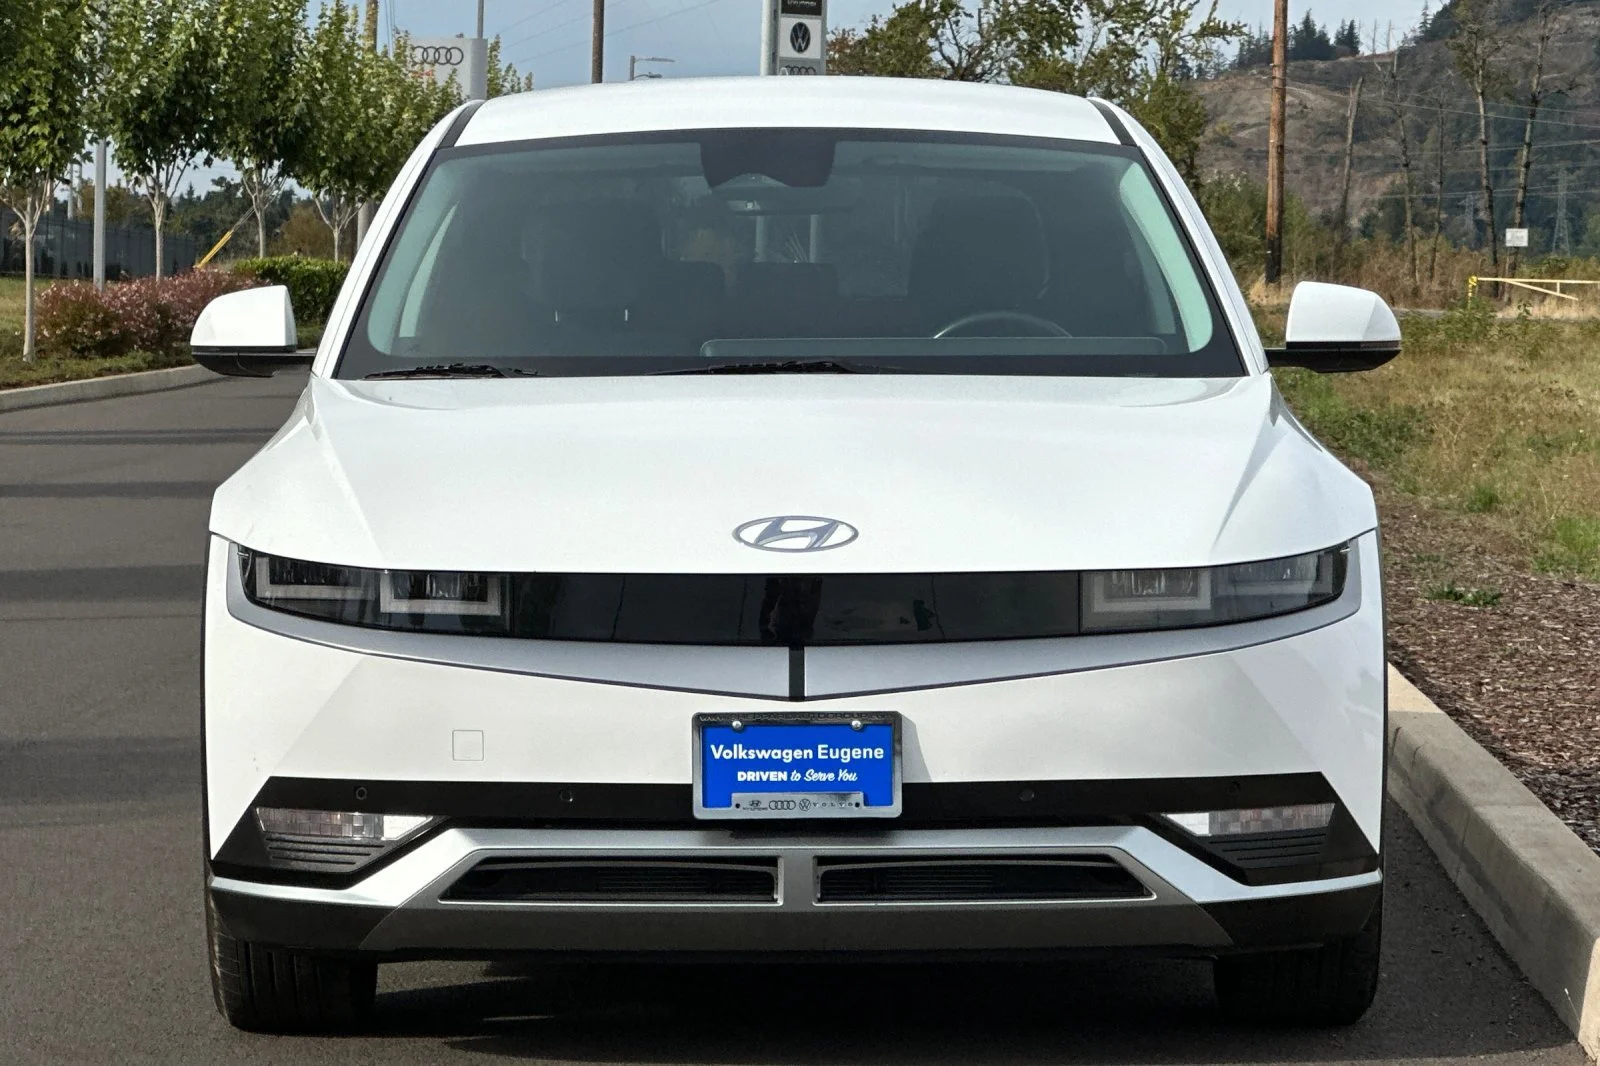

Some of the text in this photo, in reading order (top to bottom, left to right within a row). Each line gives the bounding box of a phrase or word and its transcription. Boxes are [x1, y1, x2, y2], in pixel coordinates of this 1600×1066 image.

[710, 743, 884, 763] Volkswagen Eugene
[737, 768, 858, 782] DRIVEN to Serve You
